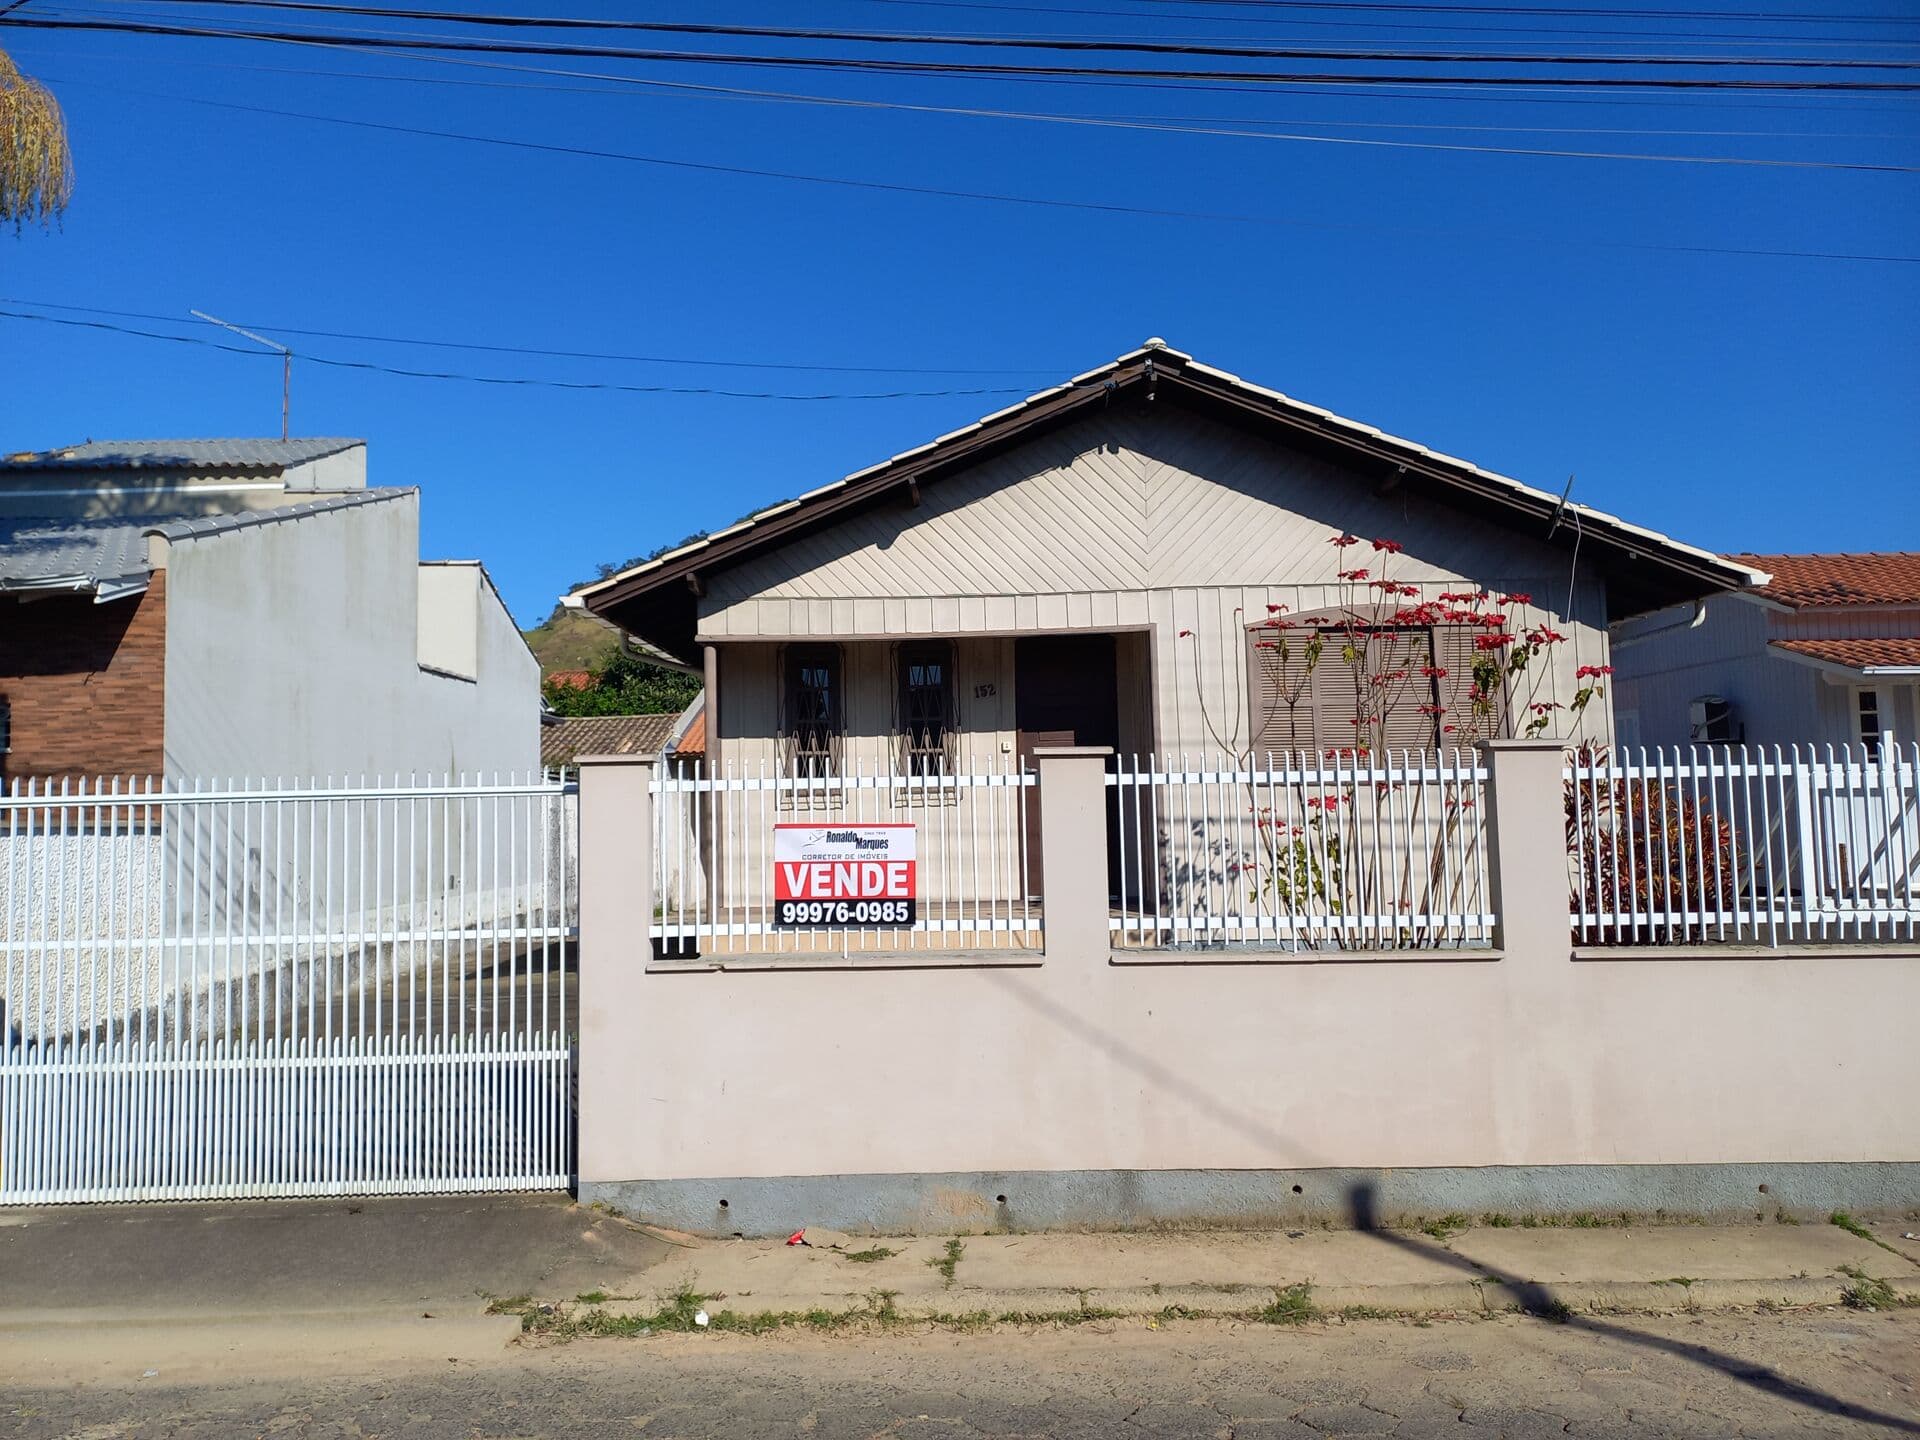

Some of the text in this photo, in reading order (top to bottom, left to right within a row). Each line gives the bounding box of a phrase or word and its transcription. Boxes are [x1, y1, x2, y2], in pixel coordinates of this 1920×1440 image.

[975, 683, 996, 698] 152
[826, 831, 858, 843] Ronaldo
[855, 838, 889, 850] Marques
[857, 851, 888, 860] IMÓVEIS
[783, 862, 908, 897] VENDE
[782, 902, 909, 923] 99976-0985
